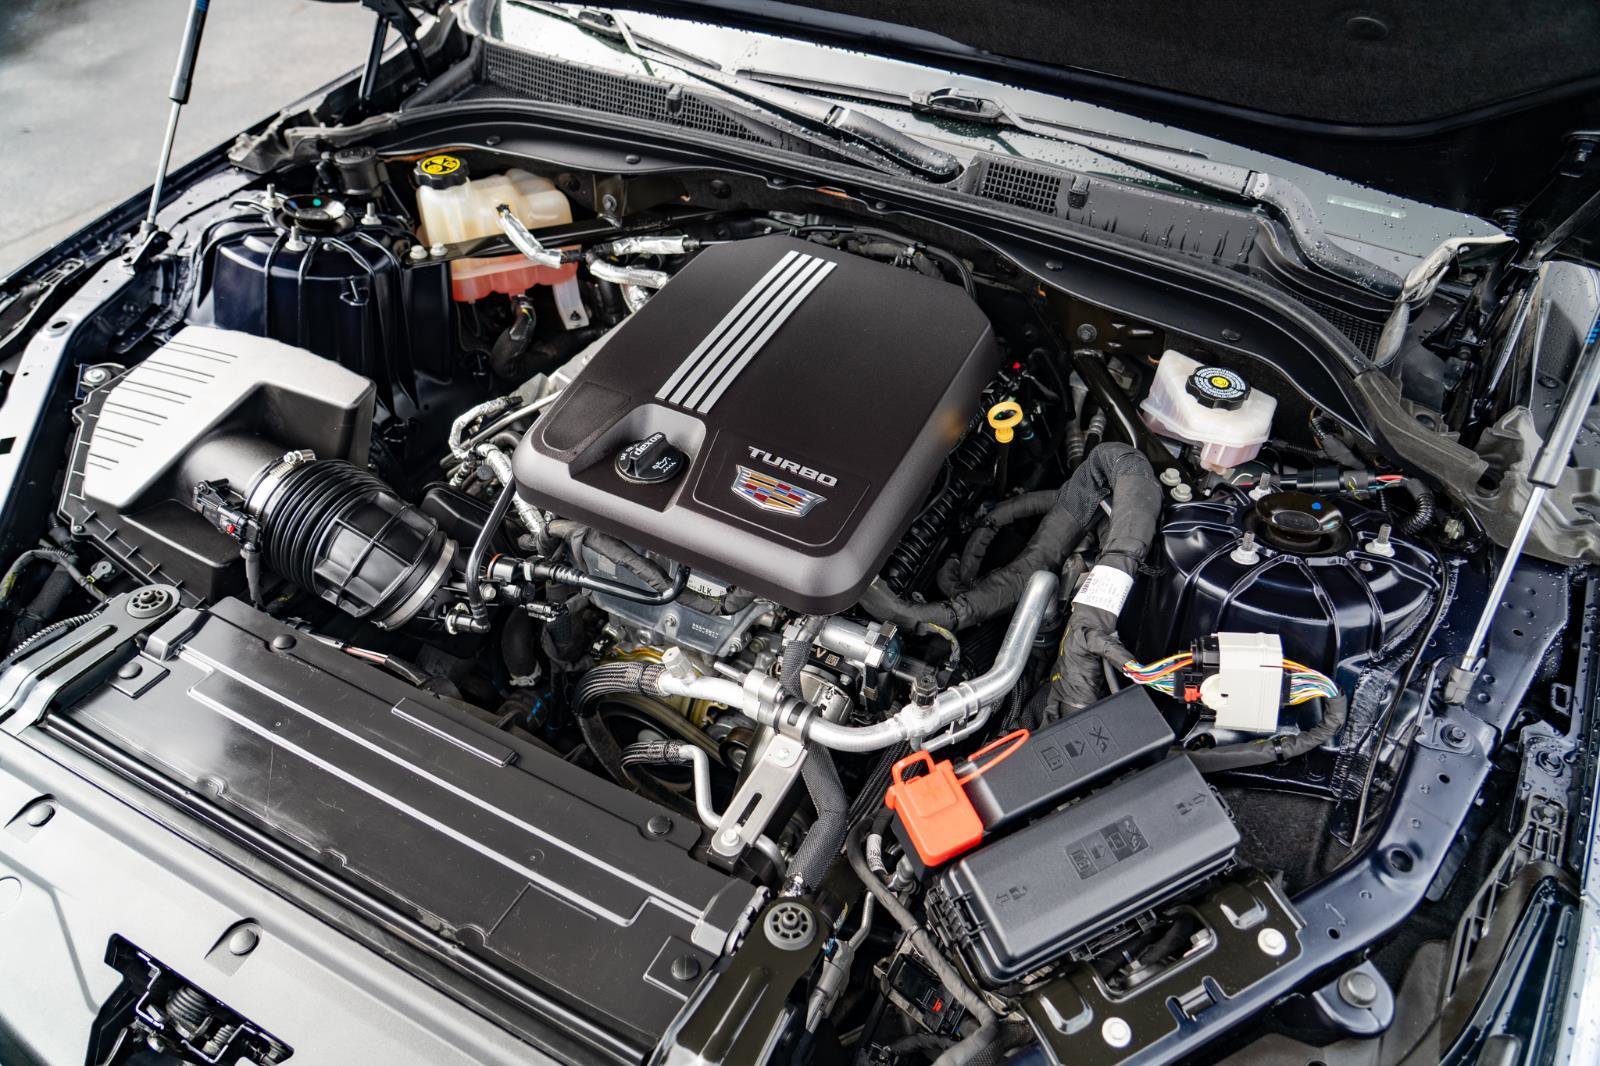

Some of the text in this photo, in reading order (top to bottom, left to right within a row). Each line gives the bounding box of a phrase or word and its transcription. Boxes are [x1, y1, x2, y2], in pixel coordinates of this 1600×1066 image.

[634, 433, 663, 456] dexos
[748, 445, 838, 487] TURBO
[697, 584, 712, 596] JLK
